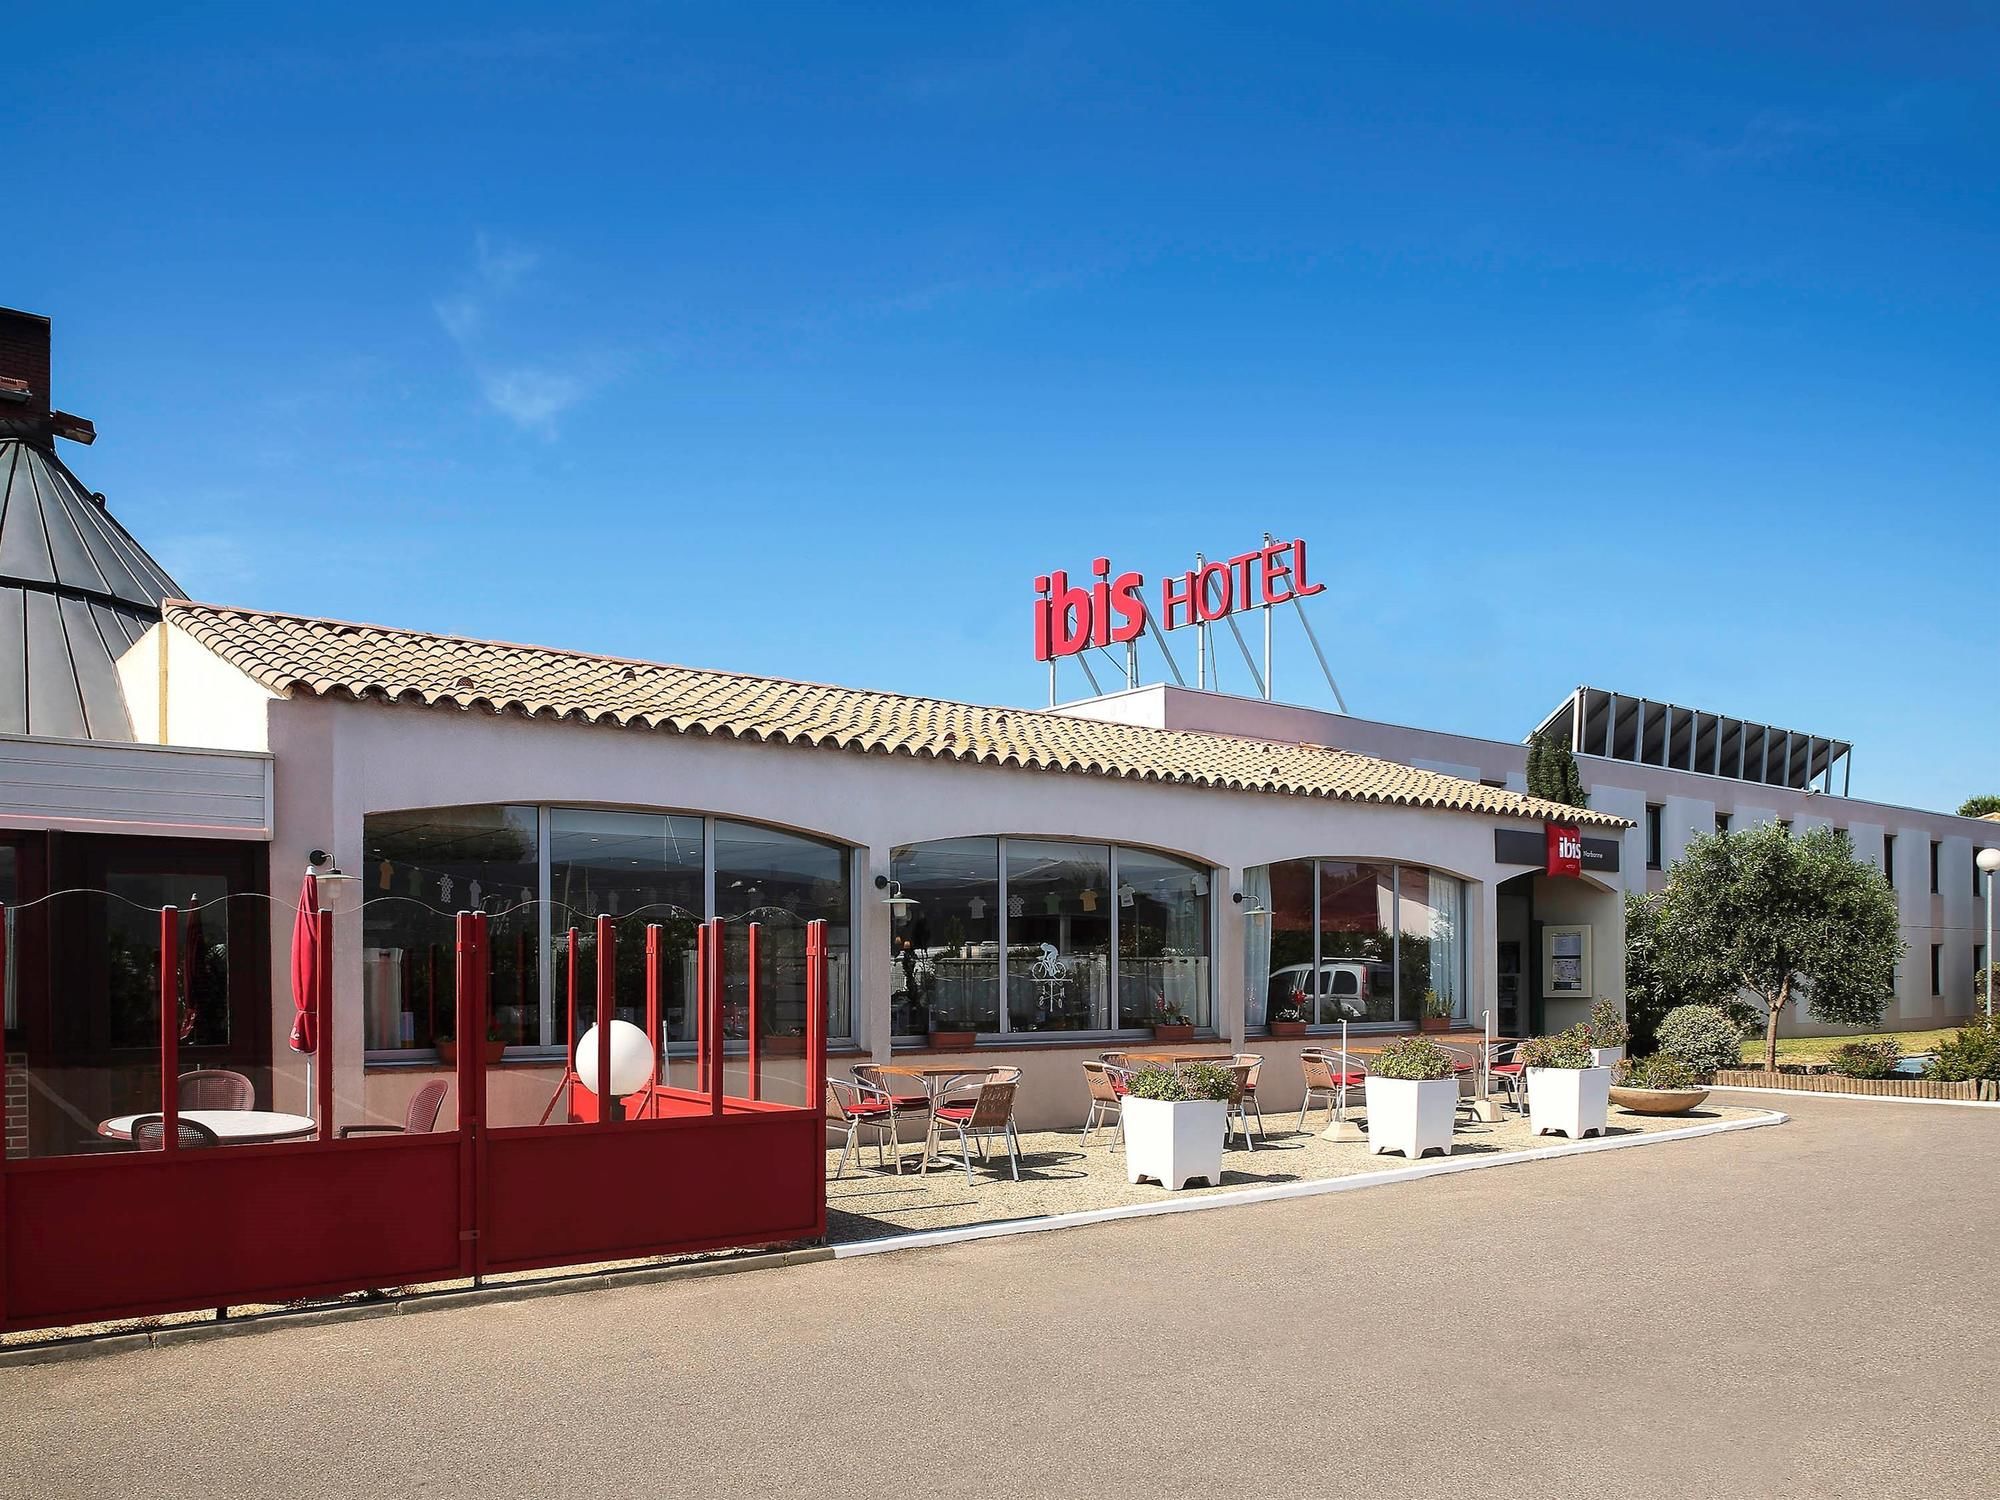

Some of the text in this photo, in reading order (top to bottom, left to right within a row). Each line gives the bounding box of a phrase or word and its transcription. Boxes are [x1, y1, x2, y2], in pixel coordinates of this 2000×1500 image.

[1034, 538, 1326, 661] ibis HOTEL
[1559, 836, 1581, 859] ibis
